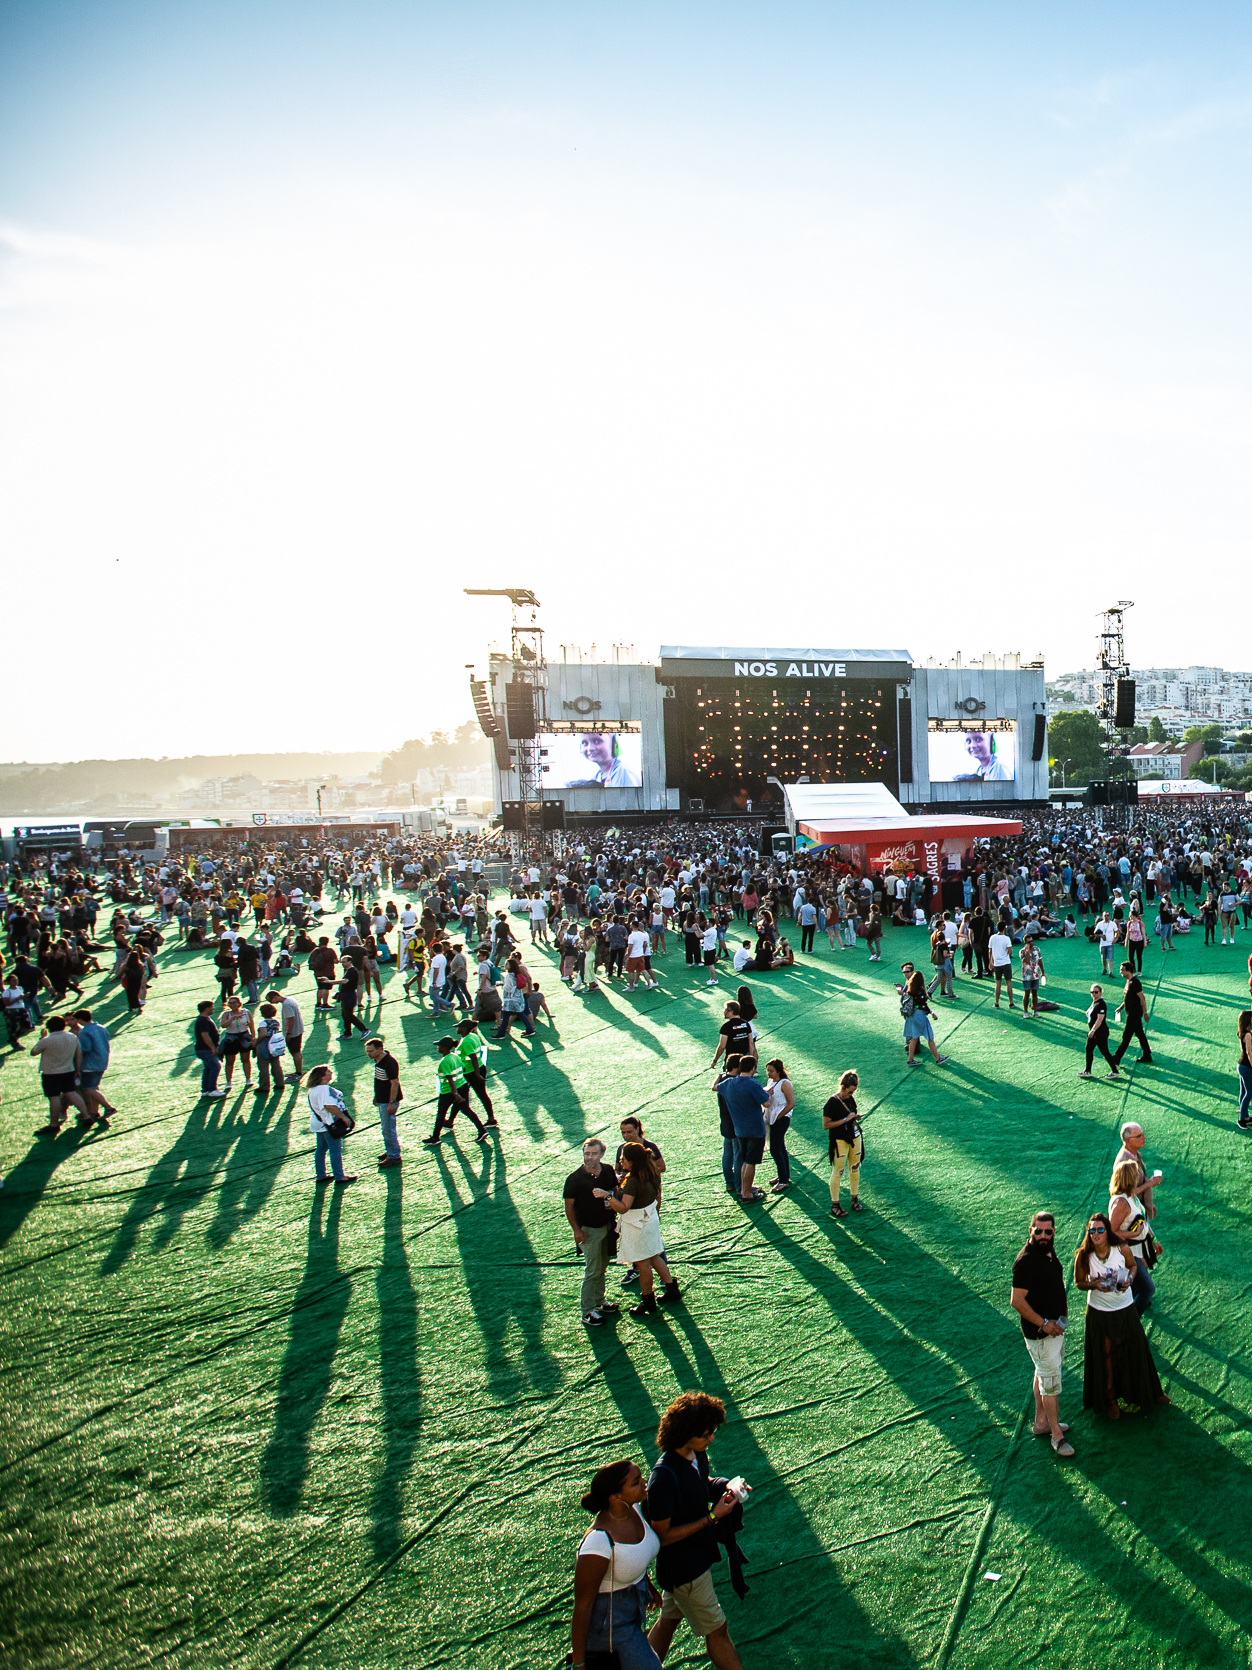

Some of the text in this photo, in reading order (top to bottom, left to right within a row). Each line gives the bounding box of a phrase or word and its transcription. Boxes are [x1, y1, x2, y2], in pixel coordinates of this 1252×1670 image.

[734, 662, 847, 677] NOS ALIVE
[562, 696, 602, 715] NOS
[954, 696, 986, 714] NOS
[924, 841, 940, 882] SAGRES
